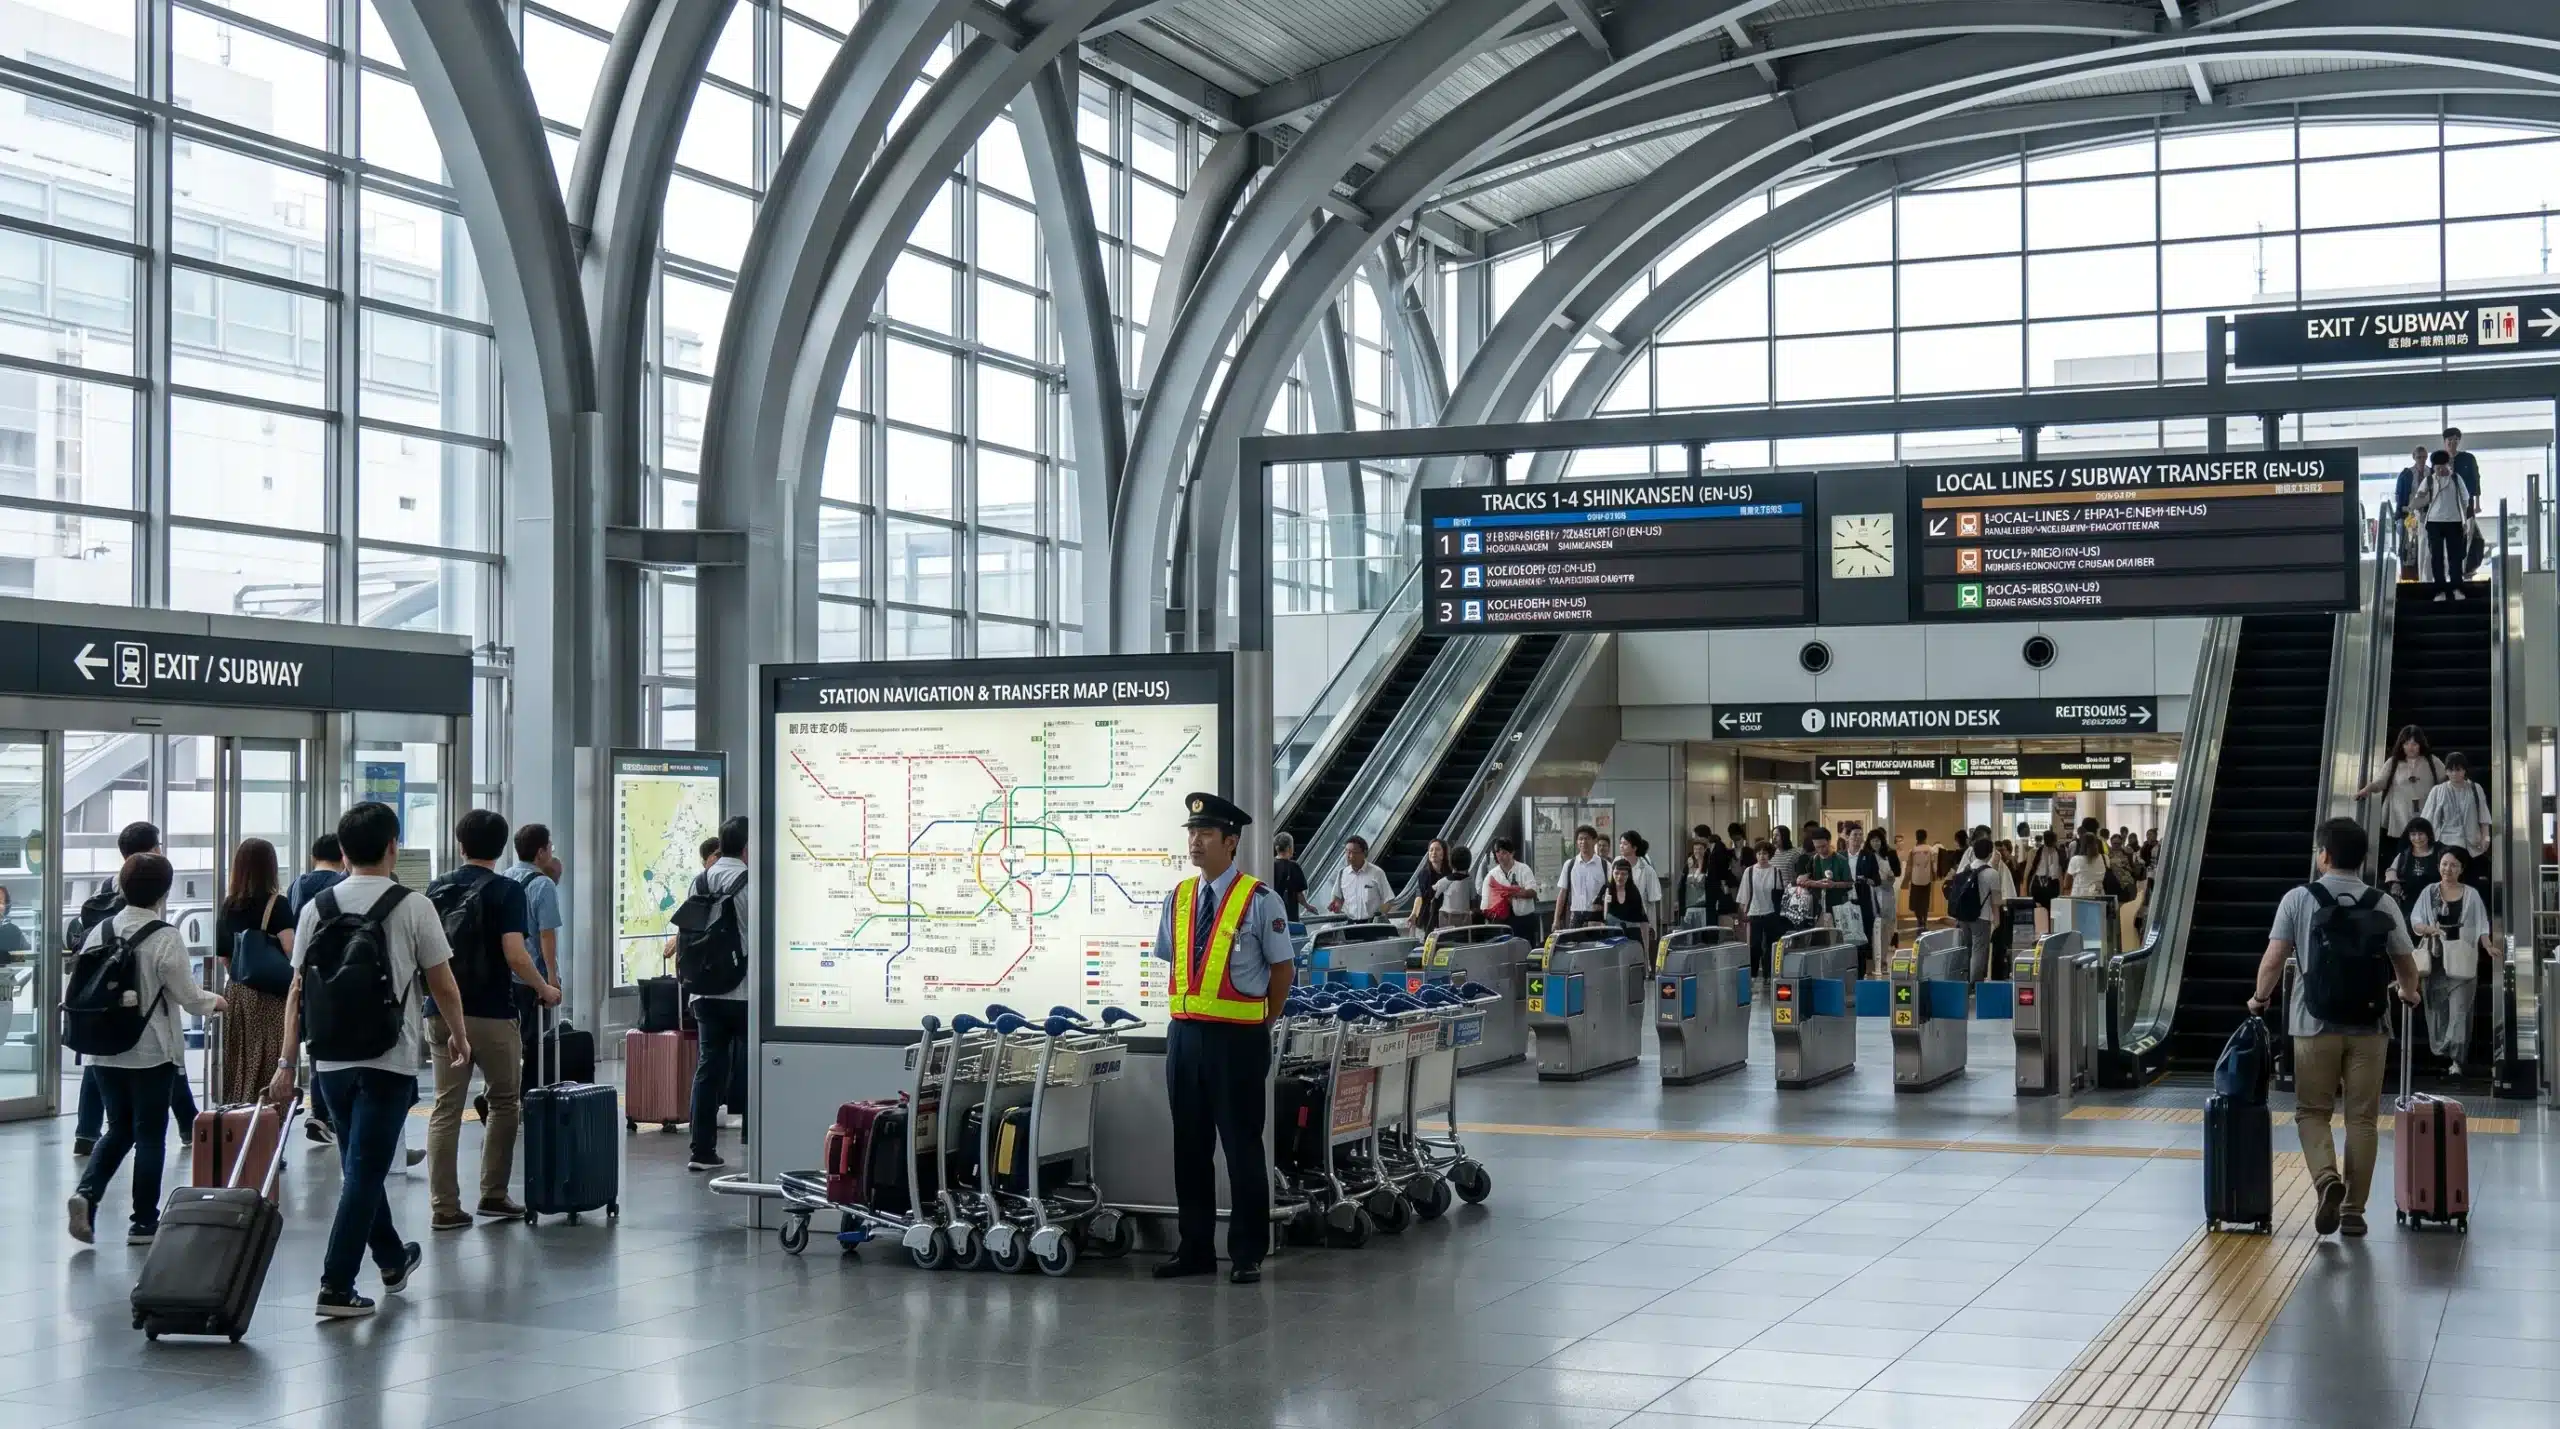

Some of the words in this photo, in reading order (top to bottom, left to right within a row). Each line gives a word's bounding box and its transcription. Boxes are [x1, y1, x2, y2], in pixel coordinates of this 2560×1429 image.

[2308, 317, 2354, 338] EXIT
[2360, 316, 2369, 336] /
[2375, 311, 2469, 334] SUBWAY
[1937, 473, 1996, 492] LOCAL
[2002, 470, 2053, 489] LINES
[2059, 469, 2066, 487] /
[2072, 466, 2152, 486] SUBWAY
[2157, 461, 2257, 482] TRANSFER
[2264, 460, 2324, 480] (EN-US)
[1482, 492, 1546, 510] TRACKS
[1553, 491, 1578, 508] 1-4
[1583, 486, 1693, 506] SHINKANSEN
[1700, 484, 1752, 503] (EN-US)
[1441, 535, 1448, 554] 1
[1441, 569, 1452, 588] 2
[1440, 603, 1452, 622] 3
[155, 653, 199, 680] EXIT
[205, 656, 214, 682] /
[220, 658, 303, 686] SUBWAY
[820, 688, 879, 704] STATION
[884, 686, 973, 702] NAVIGATION
[978, 686, 989, 700] &
[992, 684, 1069, 700] TRANSFER
[1075, 683, 1108, 698] MAP
[1113, 681, 1169, 700] (EN-US)
[1739, 712, 1763, 724] EXIT
[1831, 711, 1949, 727] INFORMATION
[1955, 710, 2000, 726] DESK
